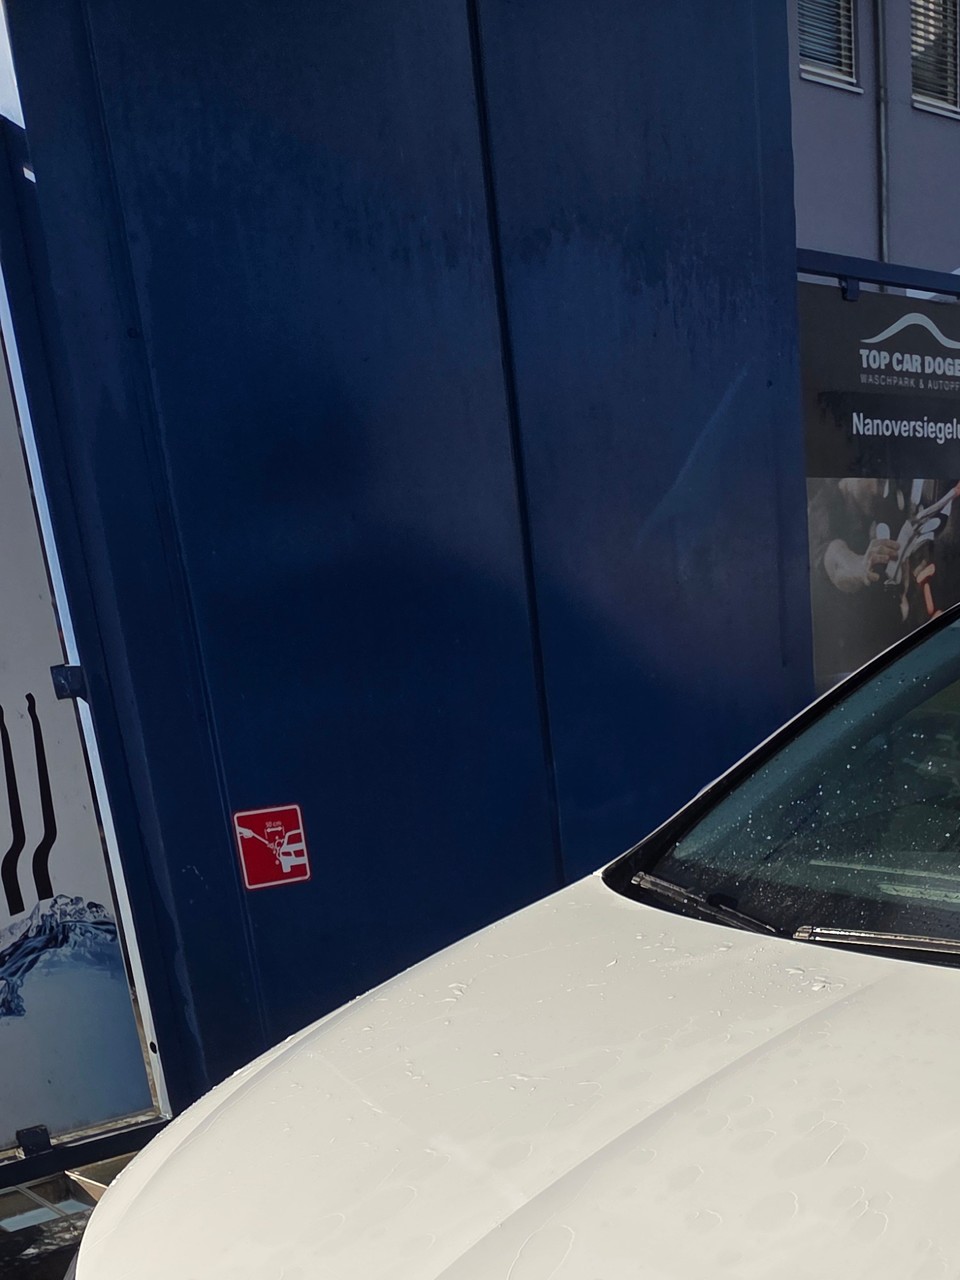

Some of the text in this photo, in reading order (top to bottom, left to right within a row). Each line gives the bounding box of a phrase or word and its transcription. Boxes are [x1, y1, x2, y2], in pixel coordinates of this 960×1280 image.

[859, 349, 890, 369] TOP
[892, 352, 922, 374] CAR
[860, 373, 916, 388] WASCHPARK
[919, 378, 925, 389] &
